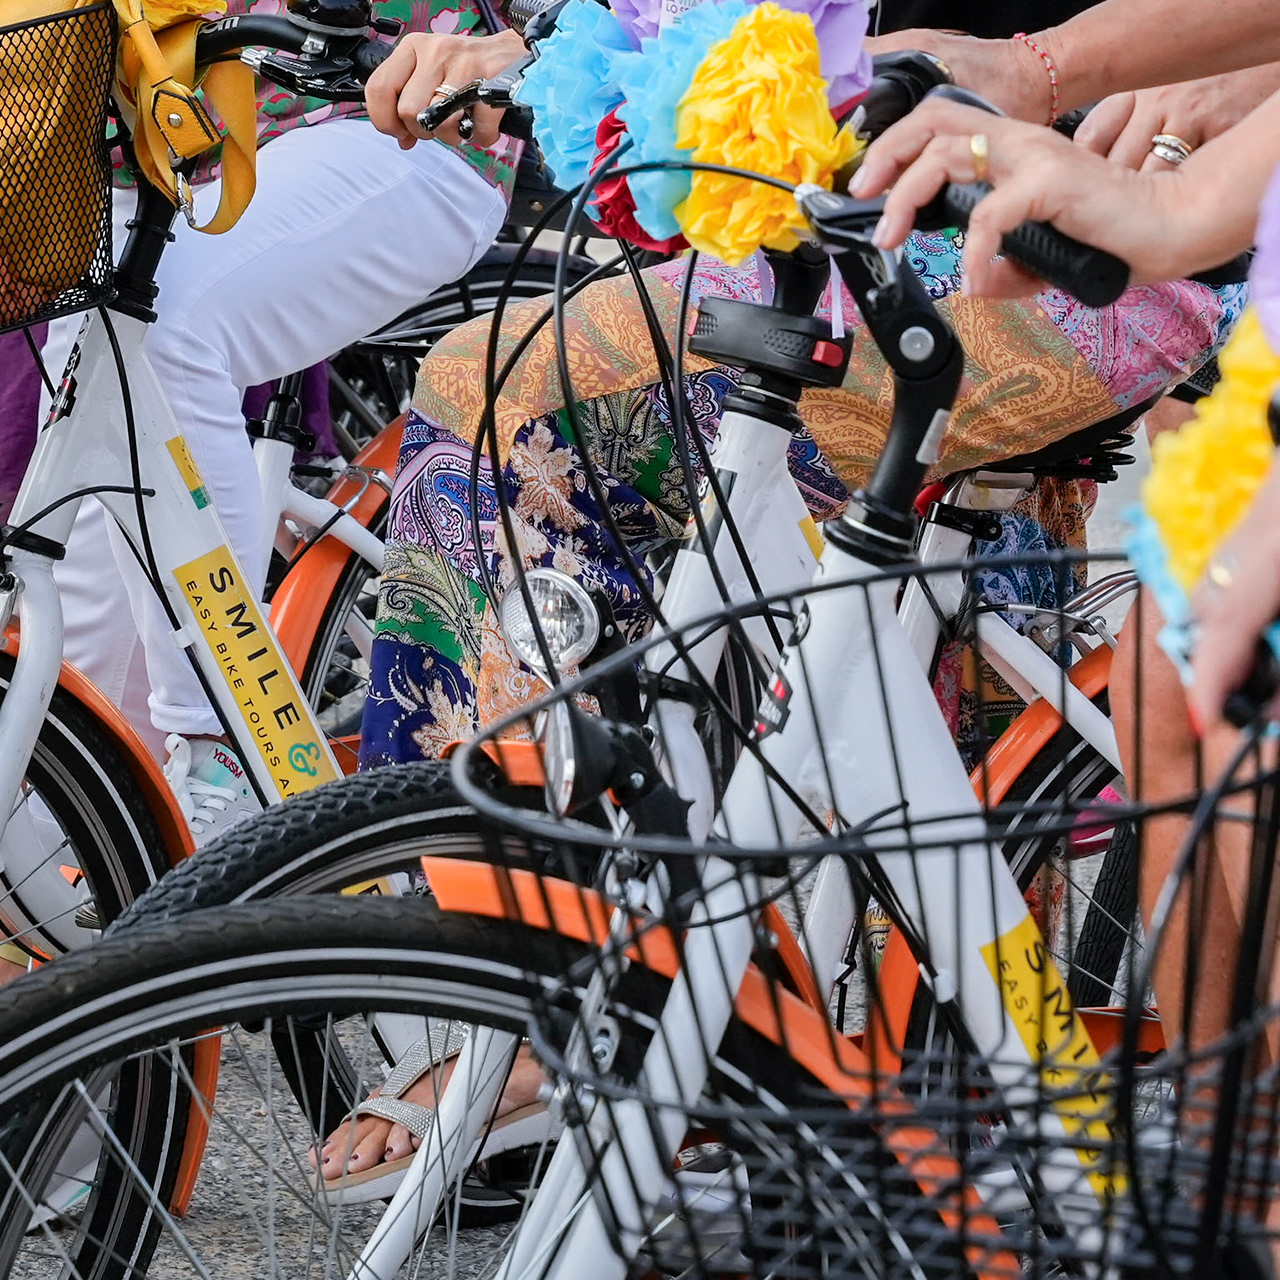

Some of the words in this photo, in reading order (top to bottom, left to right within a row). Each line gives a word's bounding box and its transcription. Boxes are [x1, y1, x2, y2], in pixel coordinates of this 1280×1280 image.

[666, 3, 678, 14] LO
[186, 580, 218, 632] EASY
[217, 642, 245, 690] BIKE
[243, 697, 281, 768] TOURS
[209, 566, 301, 731] SMILE
[287, 741, 321, 777] &
[999, 959, 1039, 1026] EASY
